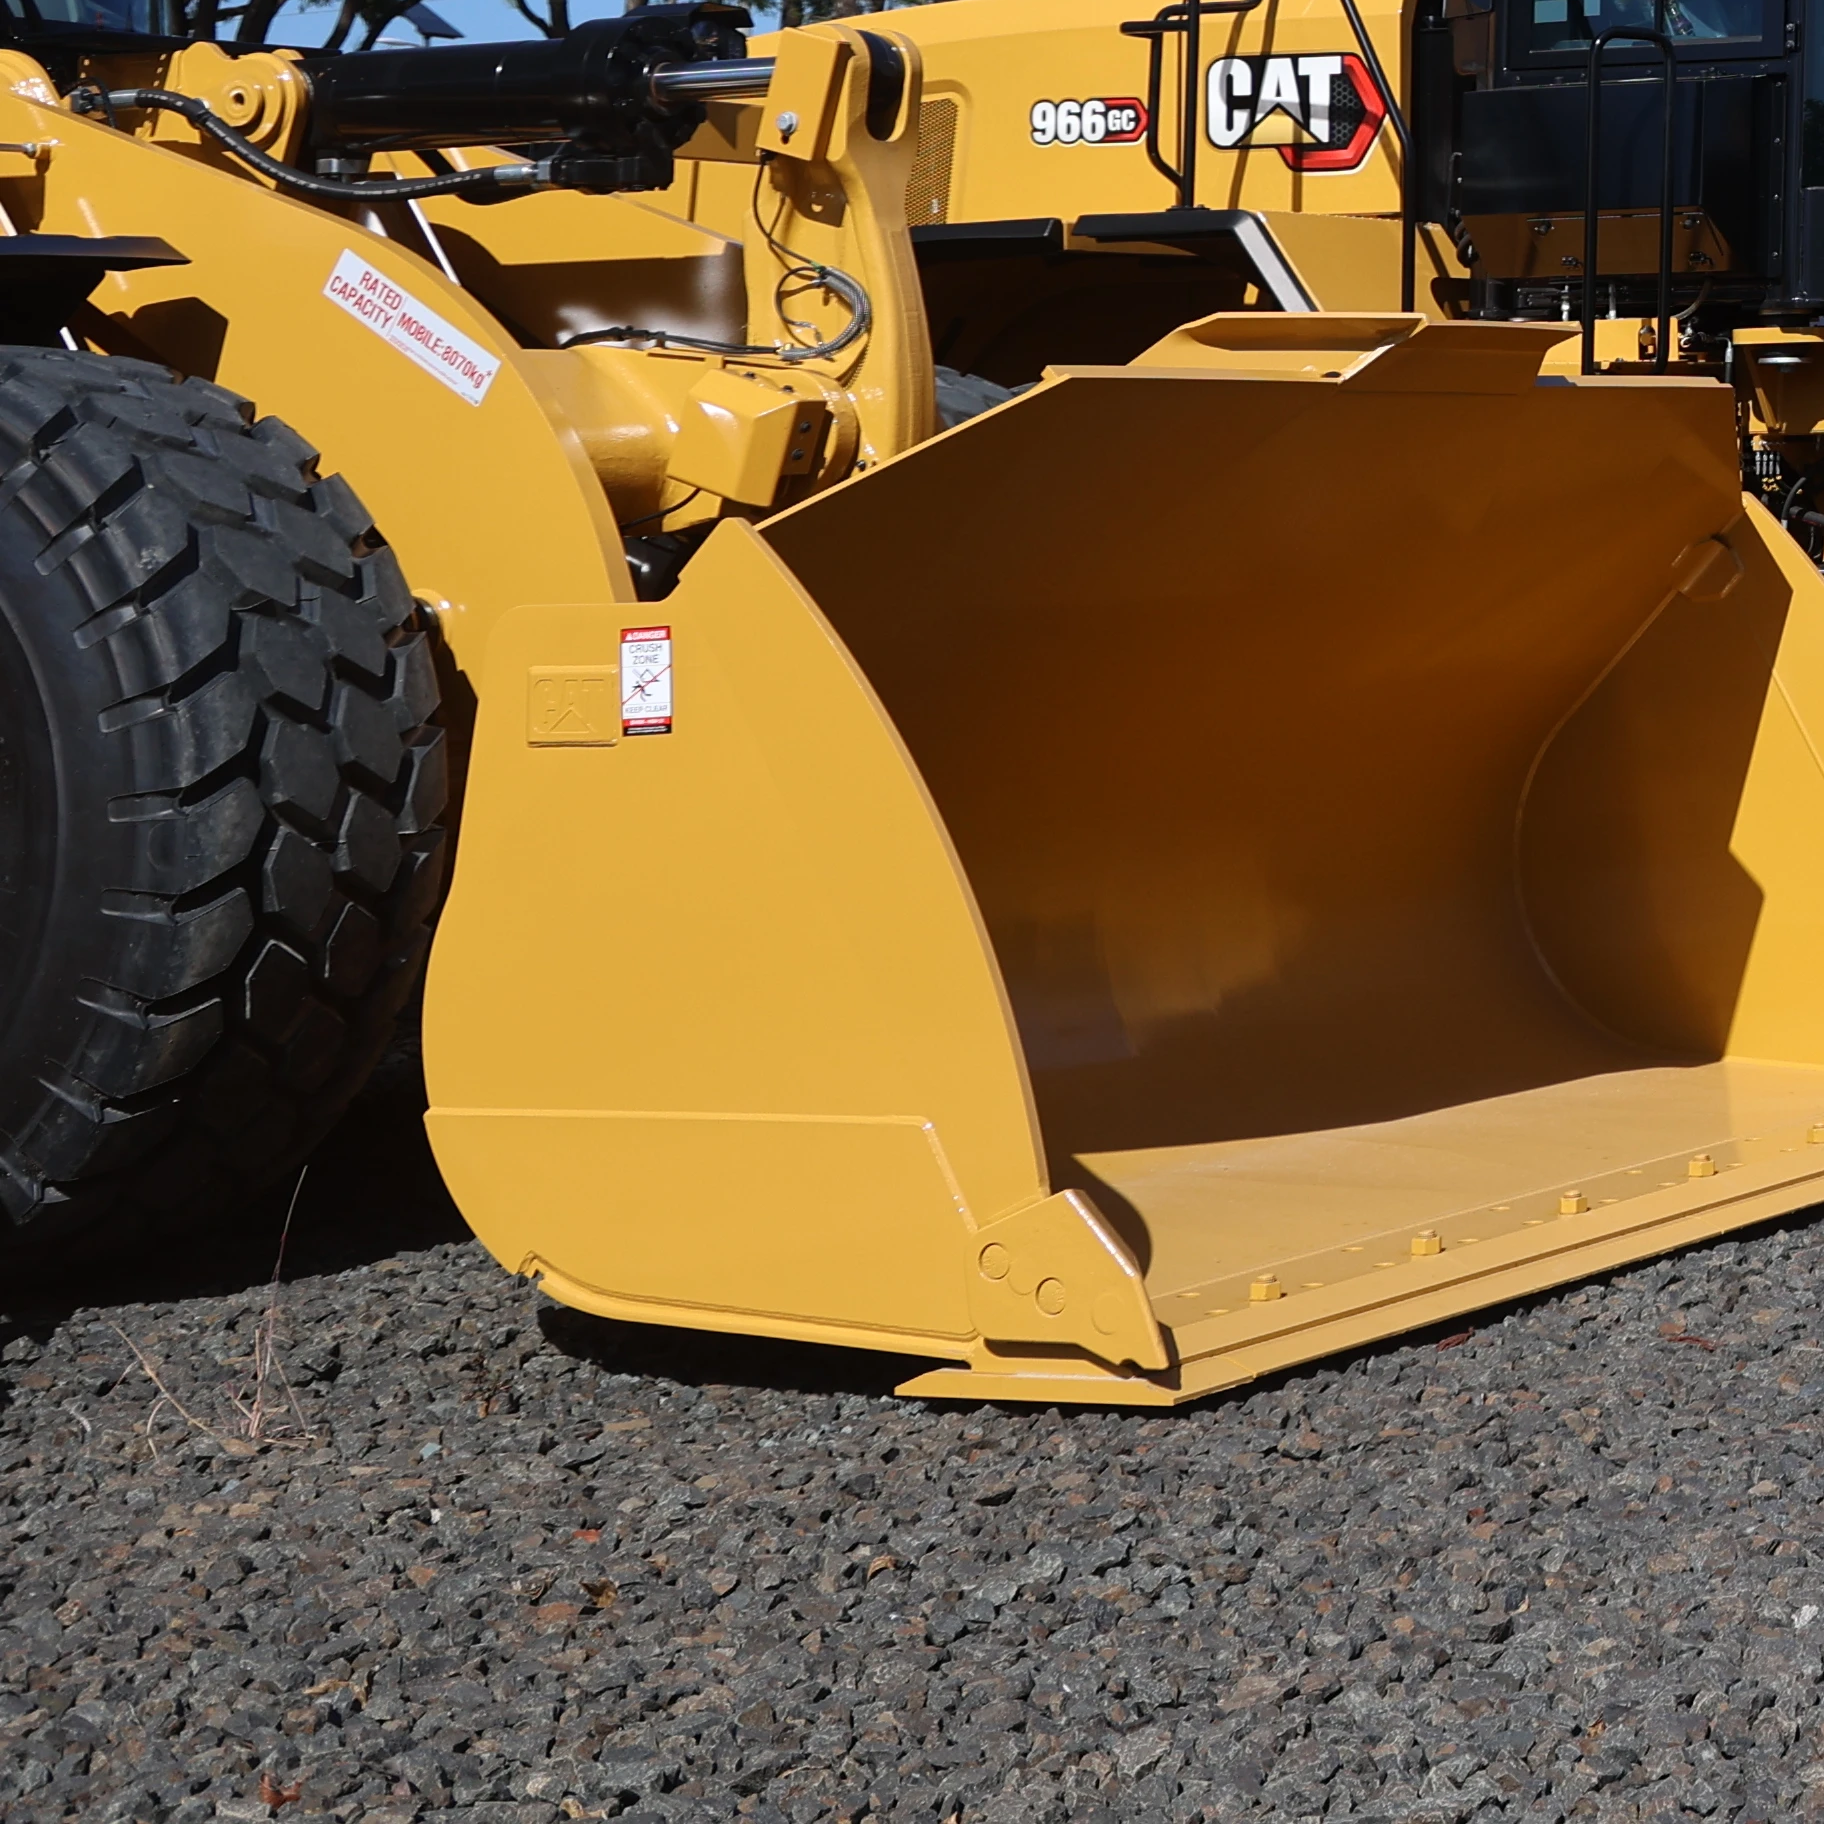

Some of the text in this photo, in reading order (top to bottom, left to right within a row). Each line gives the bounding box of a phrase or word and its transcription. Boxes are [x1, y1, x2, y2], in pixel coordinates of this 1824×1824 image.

[1030, 99, 1137, 144] 966 GC
[1206, 55, 1343, 148] CAT
[329, 275, 393, 329] CAPACITY
[358, 270, 402, 311] RATED
[629, 643, 663, 654] CRUSH
[633, 654, 660, 665] ZONE
[533, 678, 605, 734] CAT
